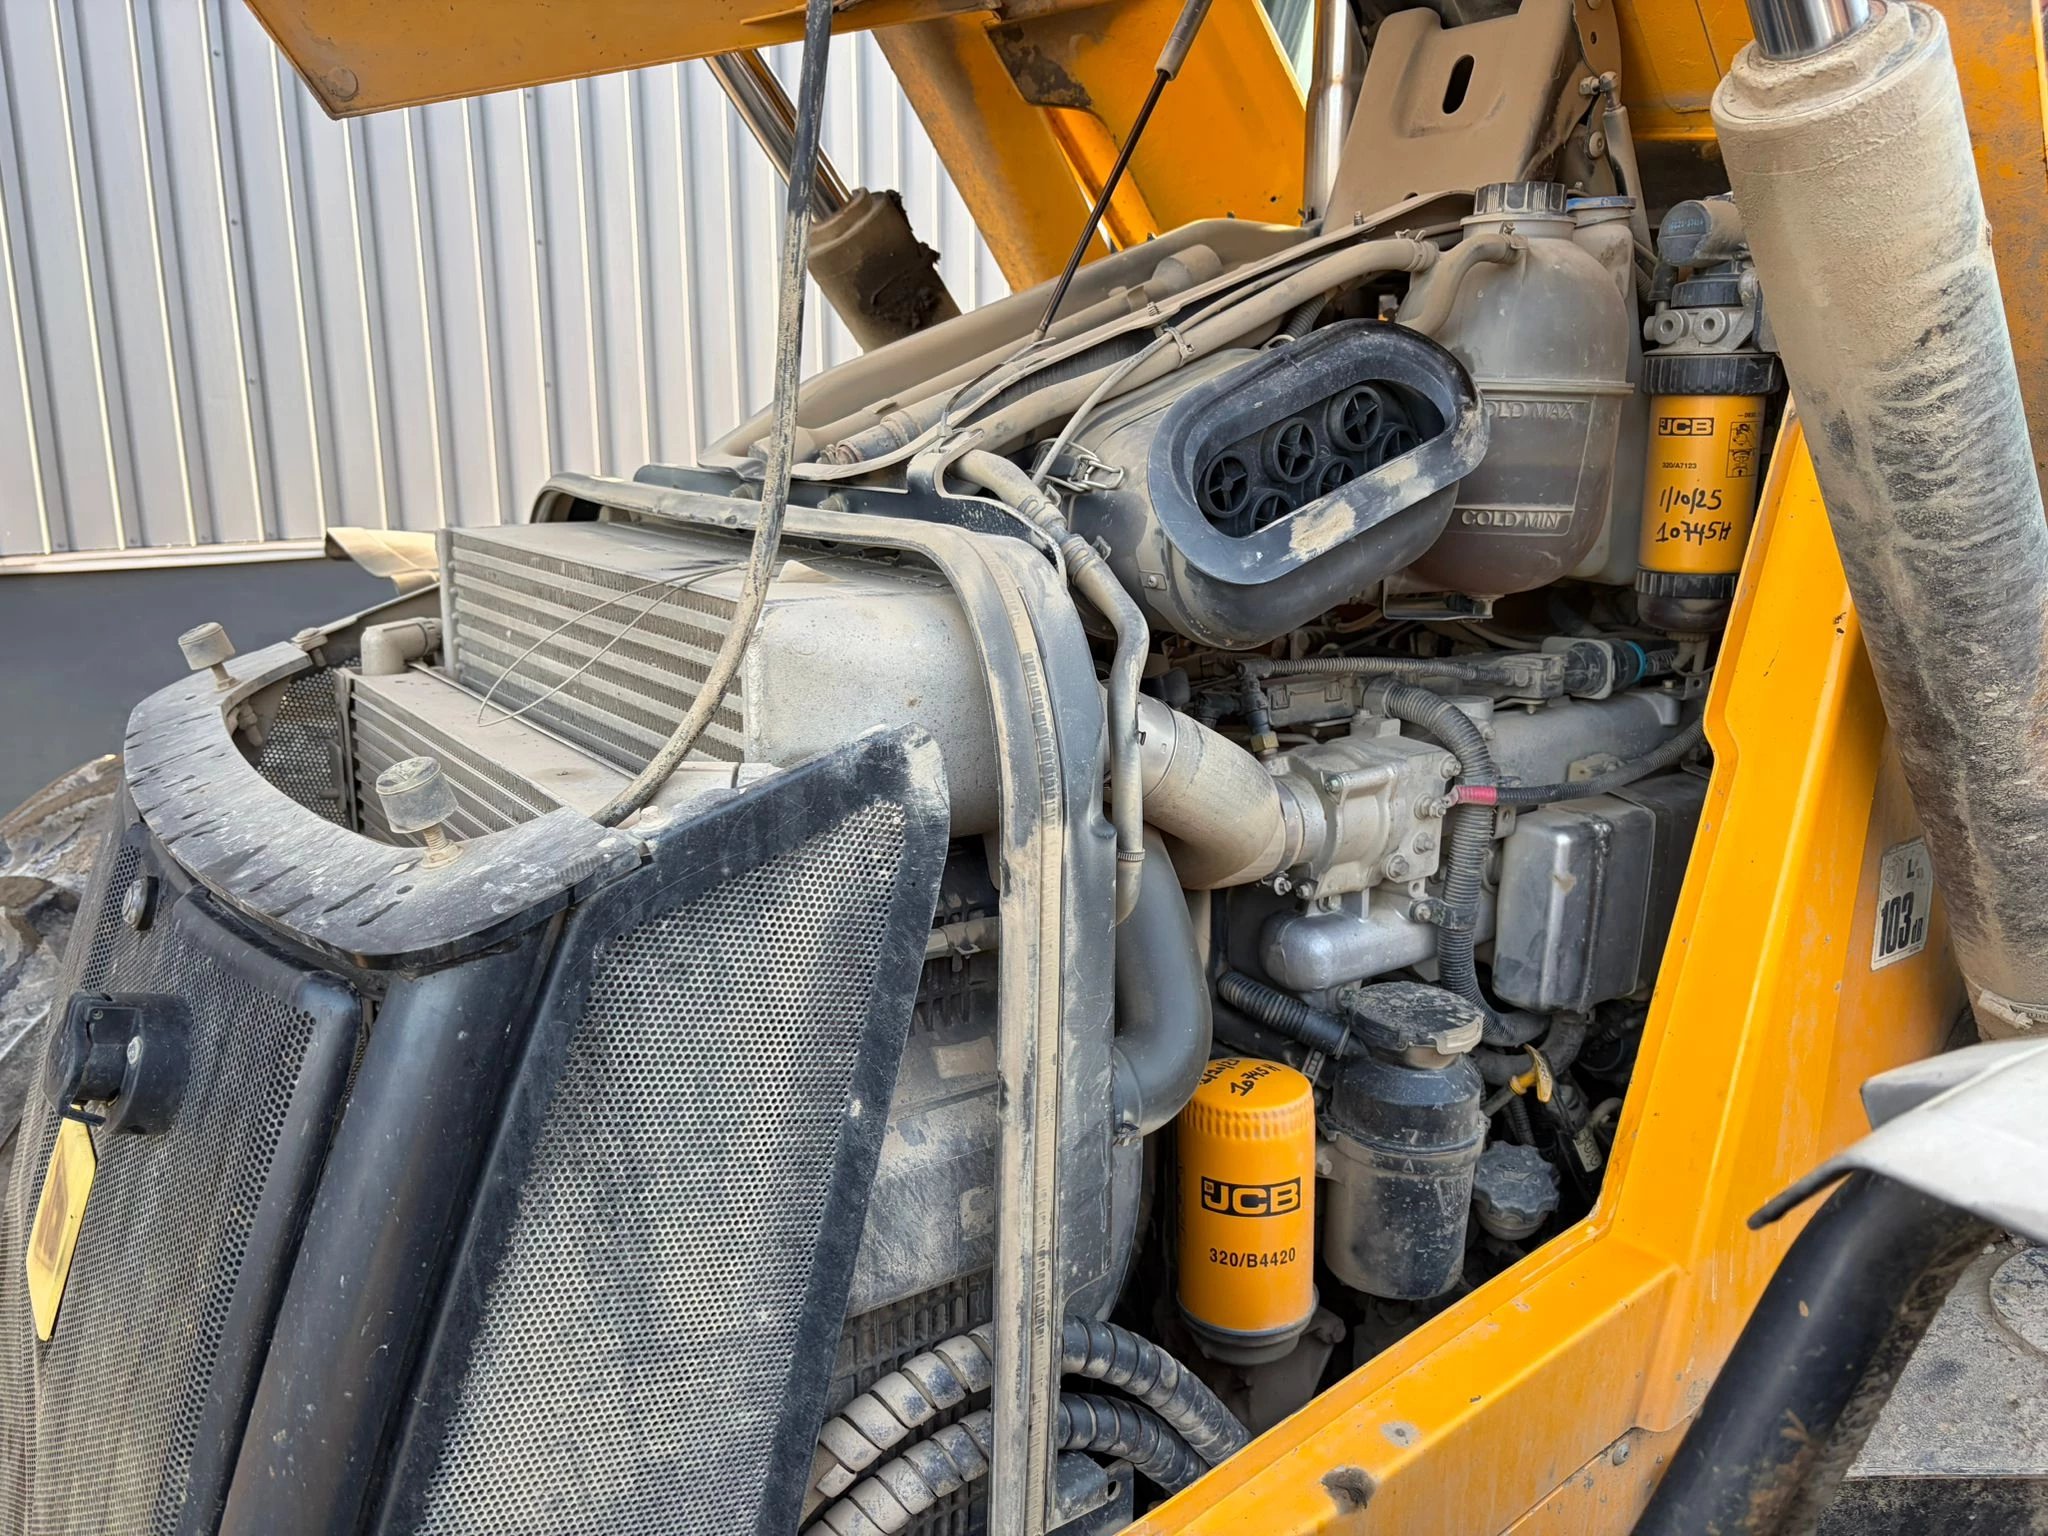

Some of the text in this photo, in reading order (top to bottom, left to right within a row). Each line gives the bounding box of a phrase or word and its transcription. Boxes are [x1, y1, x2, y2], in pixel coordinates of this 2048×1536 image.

[1484, 401, 1574, 419] OLD MAX
[1660, 418, 1713, 435] JCB
[1660, 486, 1722, 514] 1/10/25
[1462, 510, 1561, 529] COLD MIN
[1656, 521, 1732, 546] 10745H
[1880, 891, 1914, 957] 103
[1203, 1181, 1299, 1215] JCB
[1209, 1247, 1296, 1269] 320/B4420
